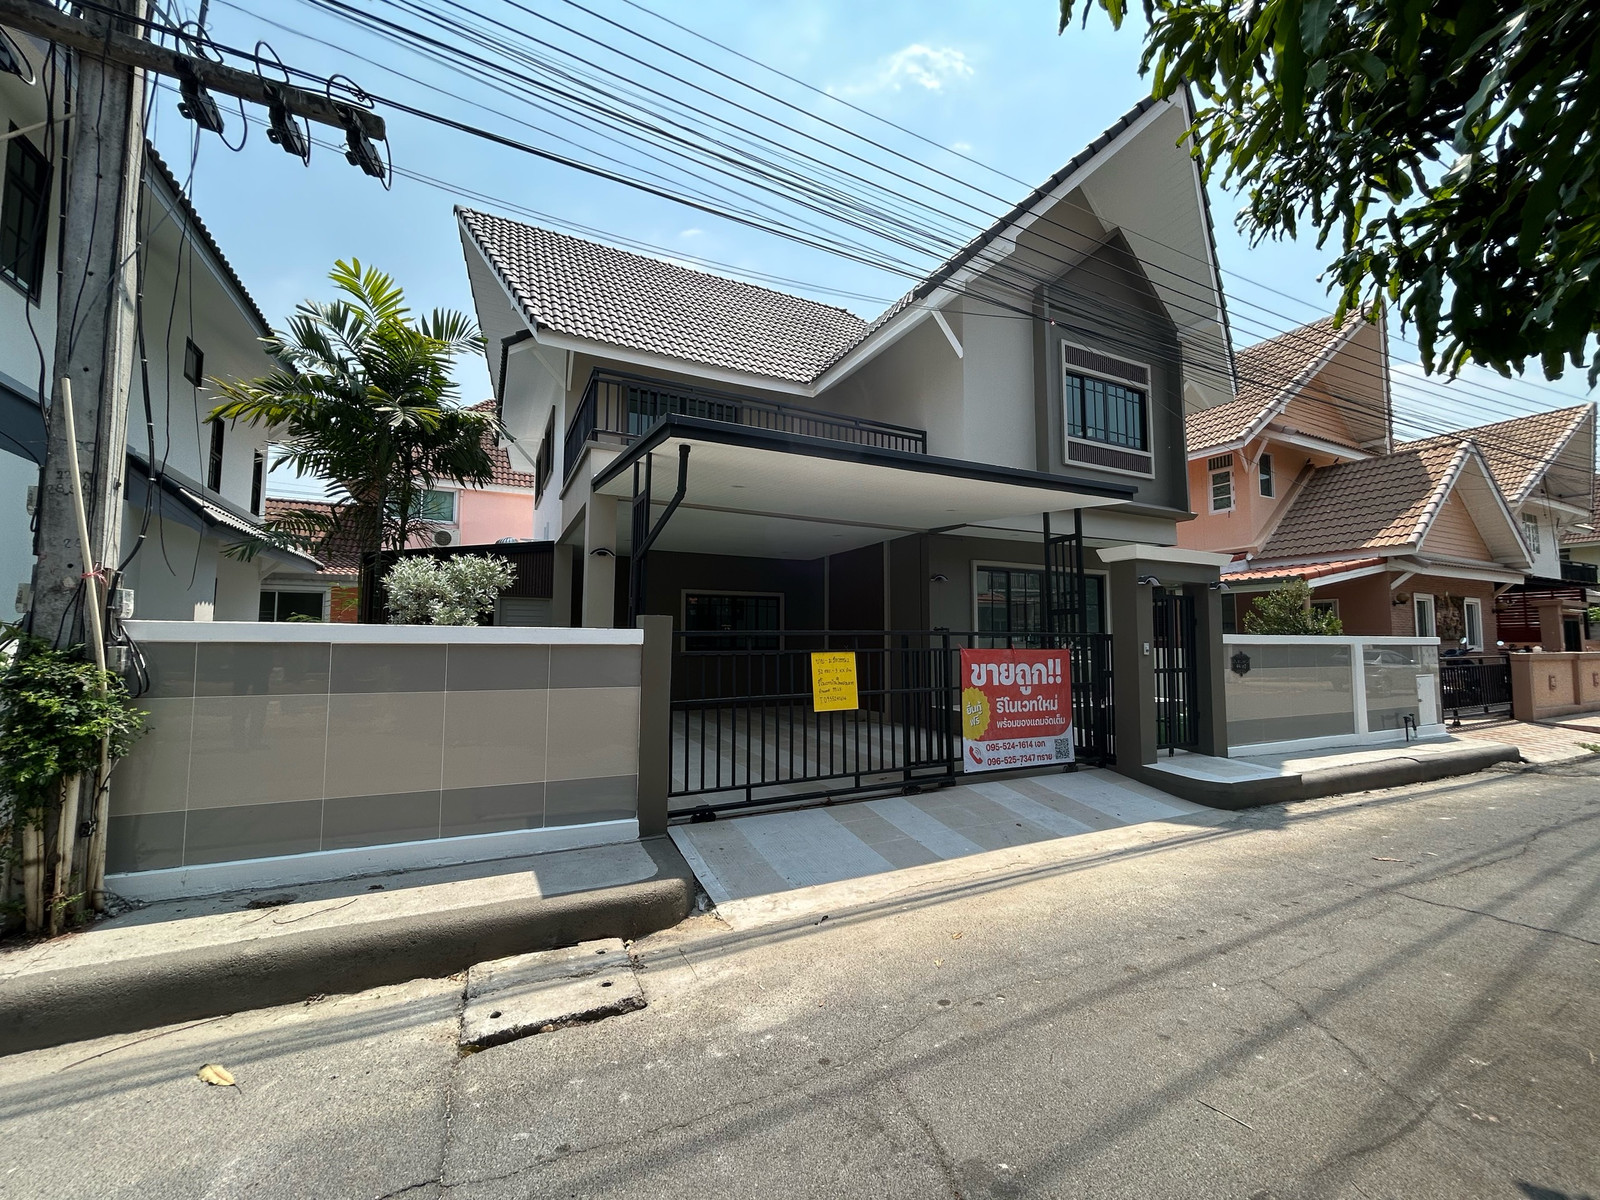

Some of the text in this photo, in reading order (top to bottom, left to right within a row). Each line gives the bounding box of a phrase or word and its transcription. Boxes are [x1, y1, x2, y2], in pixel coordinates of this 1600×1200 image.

[971, 659, 1062, 695] ขายถูก!!
[996, 694, 1058, 713] รีโนเวทใหม่
[969, 715, 980, 726] ฟรี
[996, 714, 1065, 728] พร้อมของแถมจัดเต็ม
[986, 741, 1033, 752] 095-524-1614
[987, 754, 1035, 766] 096-525-7347
